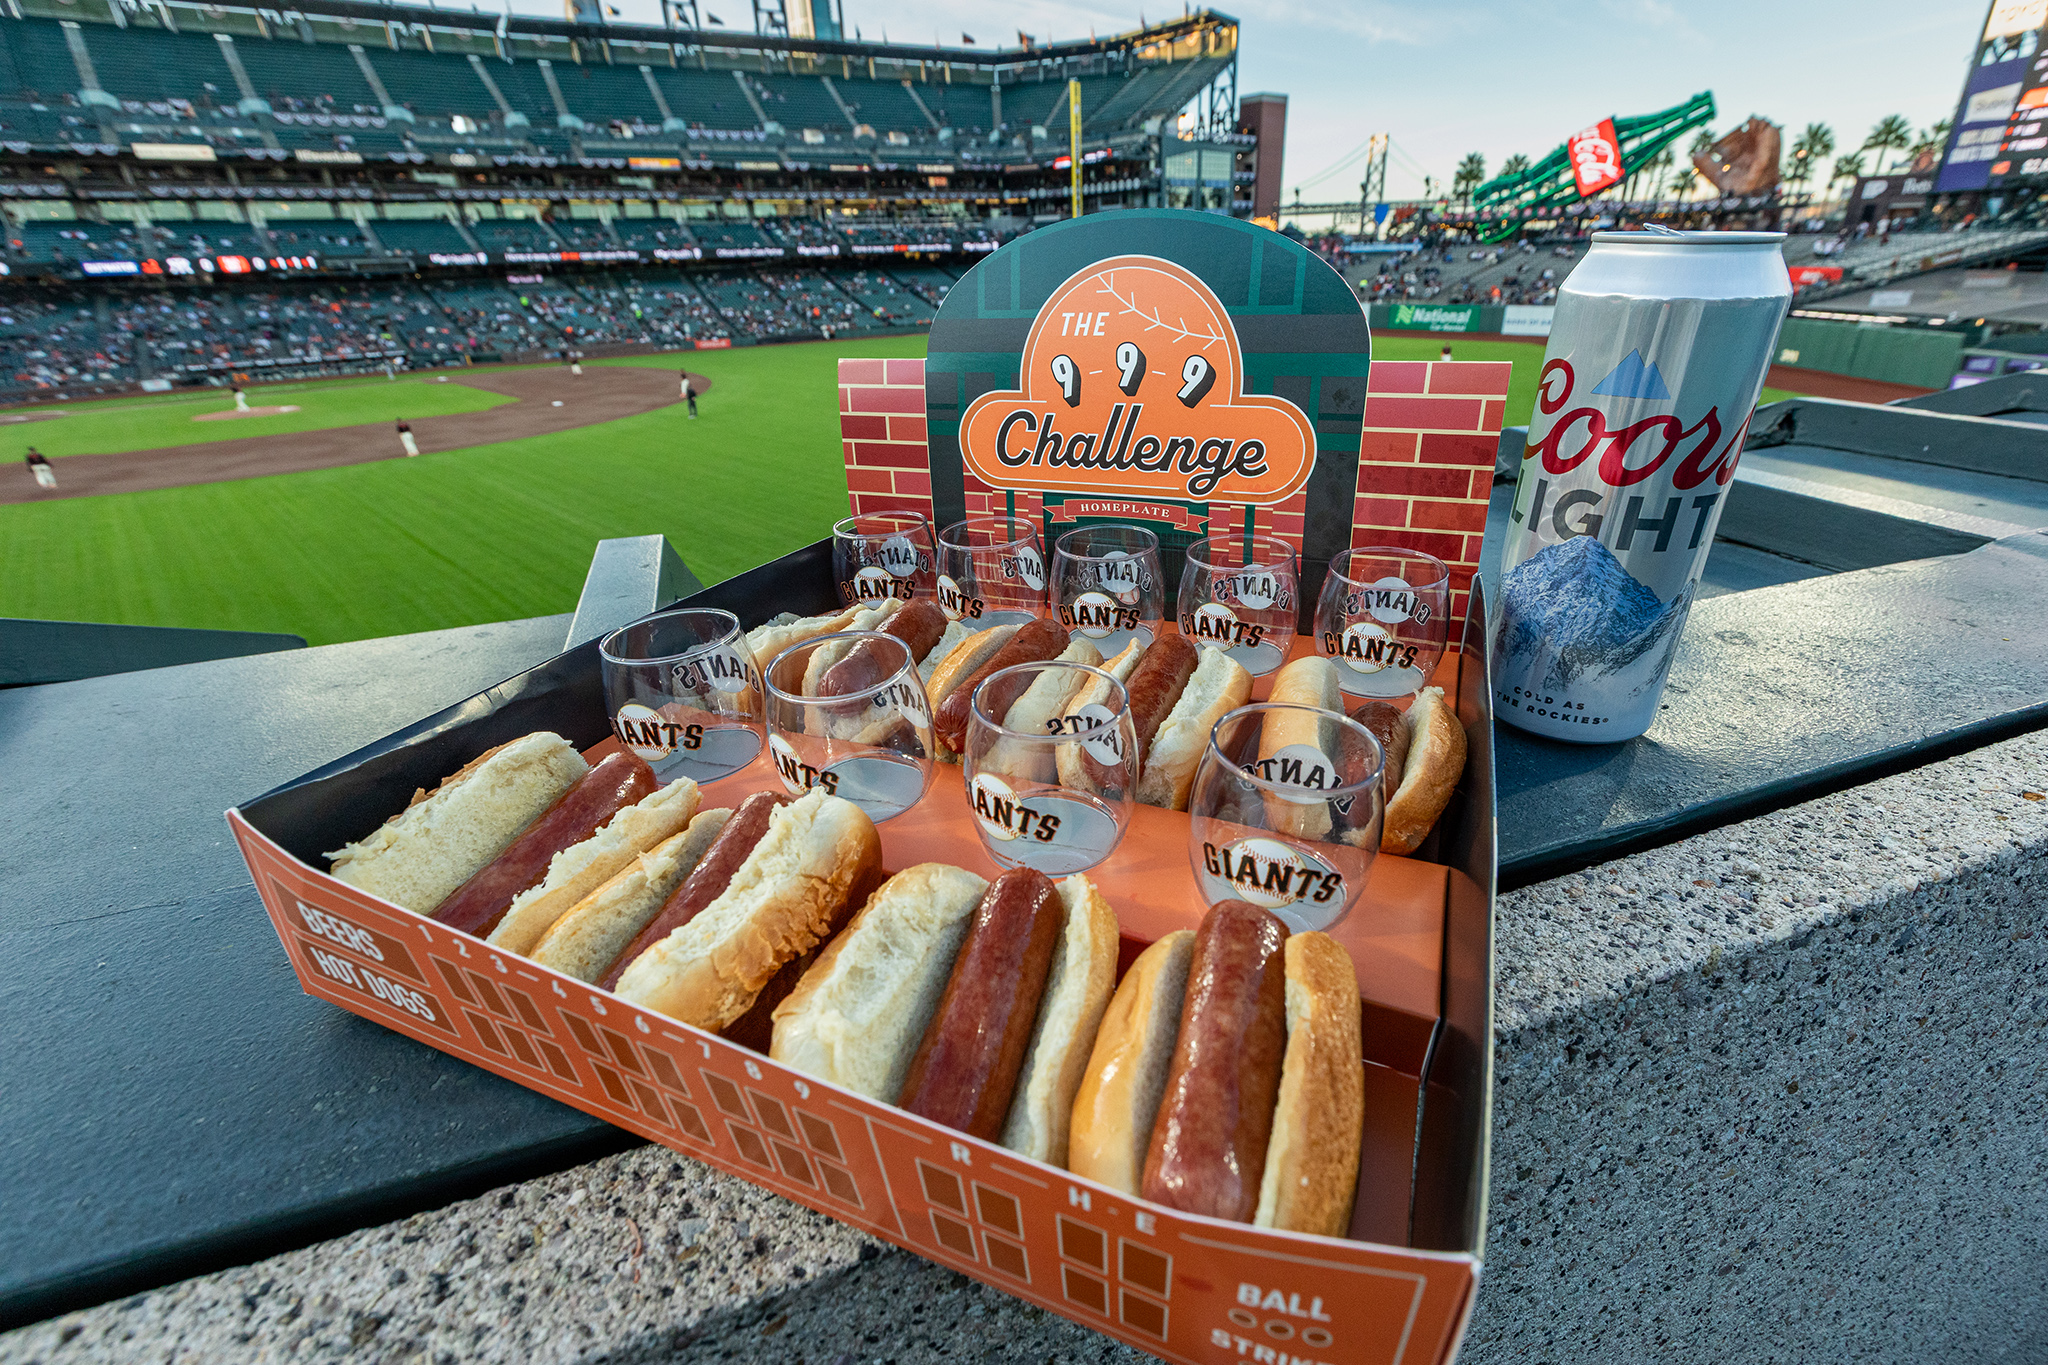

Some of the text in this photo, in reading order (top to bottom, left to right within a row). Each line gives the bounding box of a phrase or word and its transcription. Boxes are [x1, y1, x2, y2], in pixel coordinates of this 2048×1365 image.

[1061, 311, 1110, 337] THE
[1412, 307, 1472, 324] National
[995, 403, 1270, 496] Challenge
[1080, 503, 1171, 519] HOMEPLATE
[840, 578, 916, 602] GIANTS
[1059, 603, 1141, 632] GIANTS
[1182, 612, 1265, 648] GIANTS
[1324, 630, 1419, 669] GIANTS
[1496, 690, 1520, 708] THE
[1513, 686, 1585, 711] COLD AS
[1202, 841, 1343, 903] GIANTS
[296, 900, 385, 962] BEERS
[309, 947, 436, 1022] HOT DOGS
[418, 924, 1156, 1236] 1 2 3 4 5 6 7 8 9 R H E
[1236, 1281, 1332, 1323] BALL
